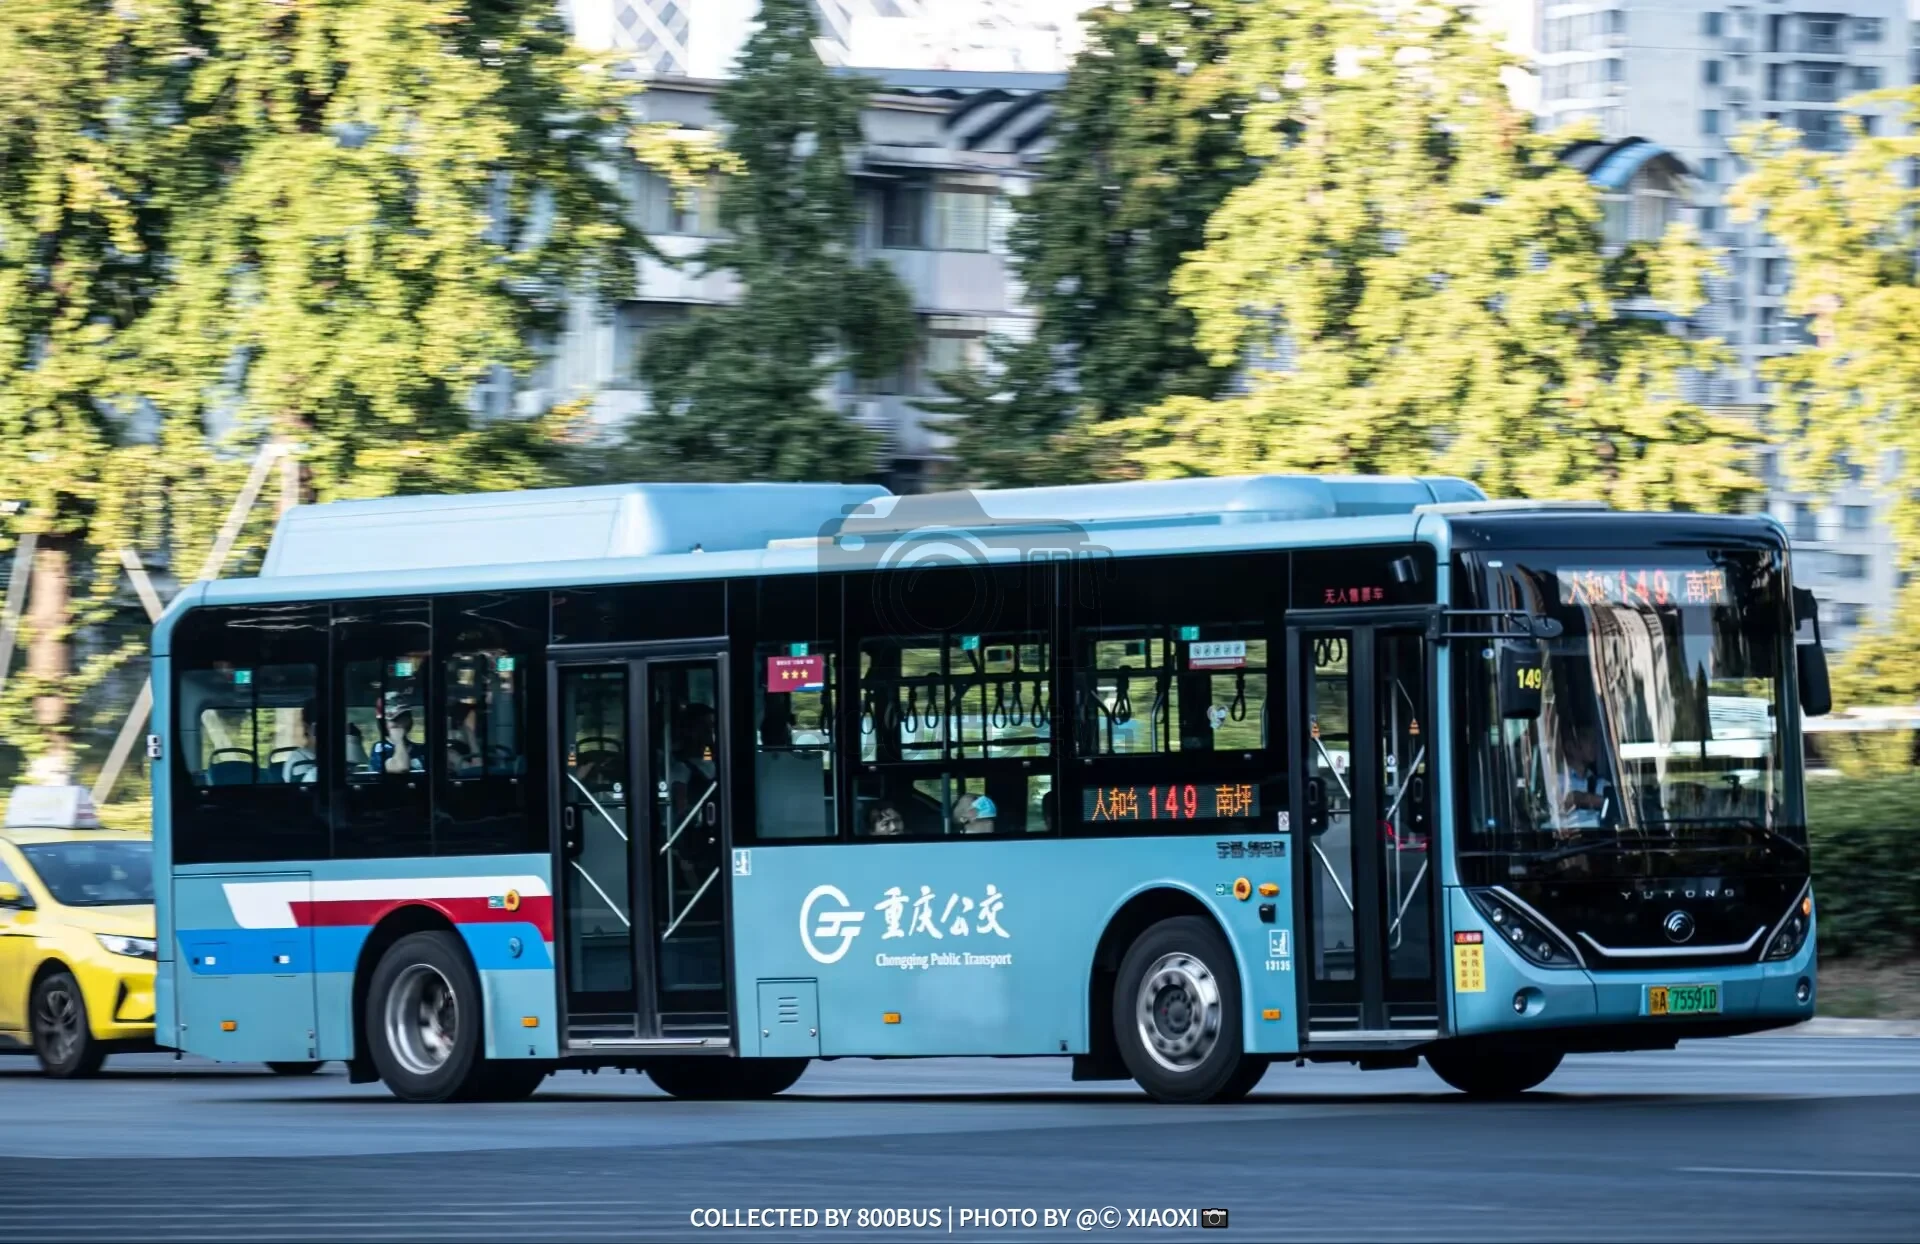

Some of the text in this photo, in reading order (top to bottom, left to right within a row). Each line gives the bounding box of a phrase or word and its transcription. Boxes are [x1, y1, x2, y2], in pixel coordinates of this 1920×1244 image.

[1517, 668, 1542, 690] 149
[1148, 784, 1198, 820] 149
[1215, 783, 1253, 818] 南坪
[1621, 888, 1735, 900] YUTONG
[873, 884, 1011, 940] 重庆公交
[875, 952, 1012, 970] Chongqing Public Transport
